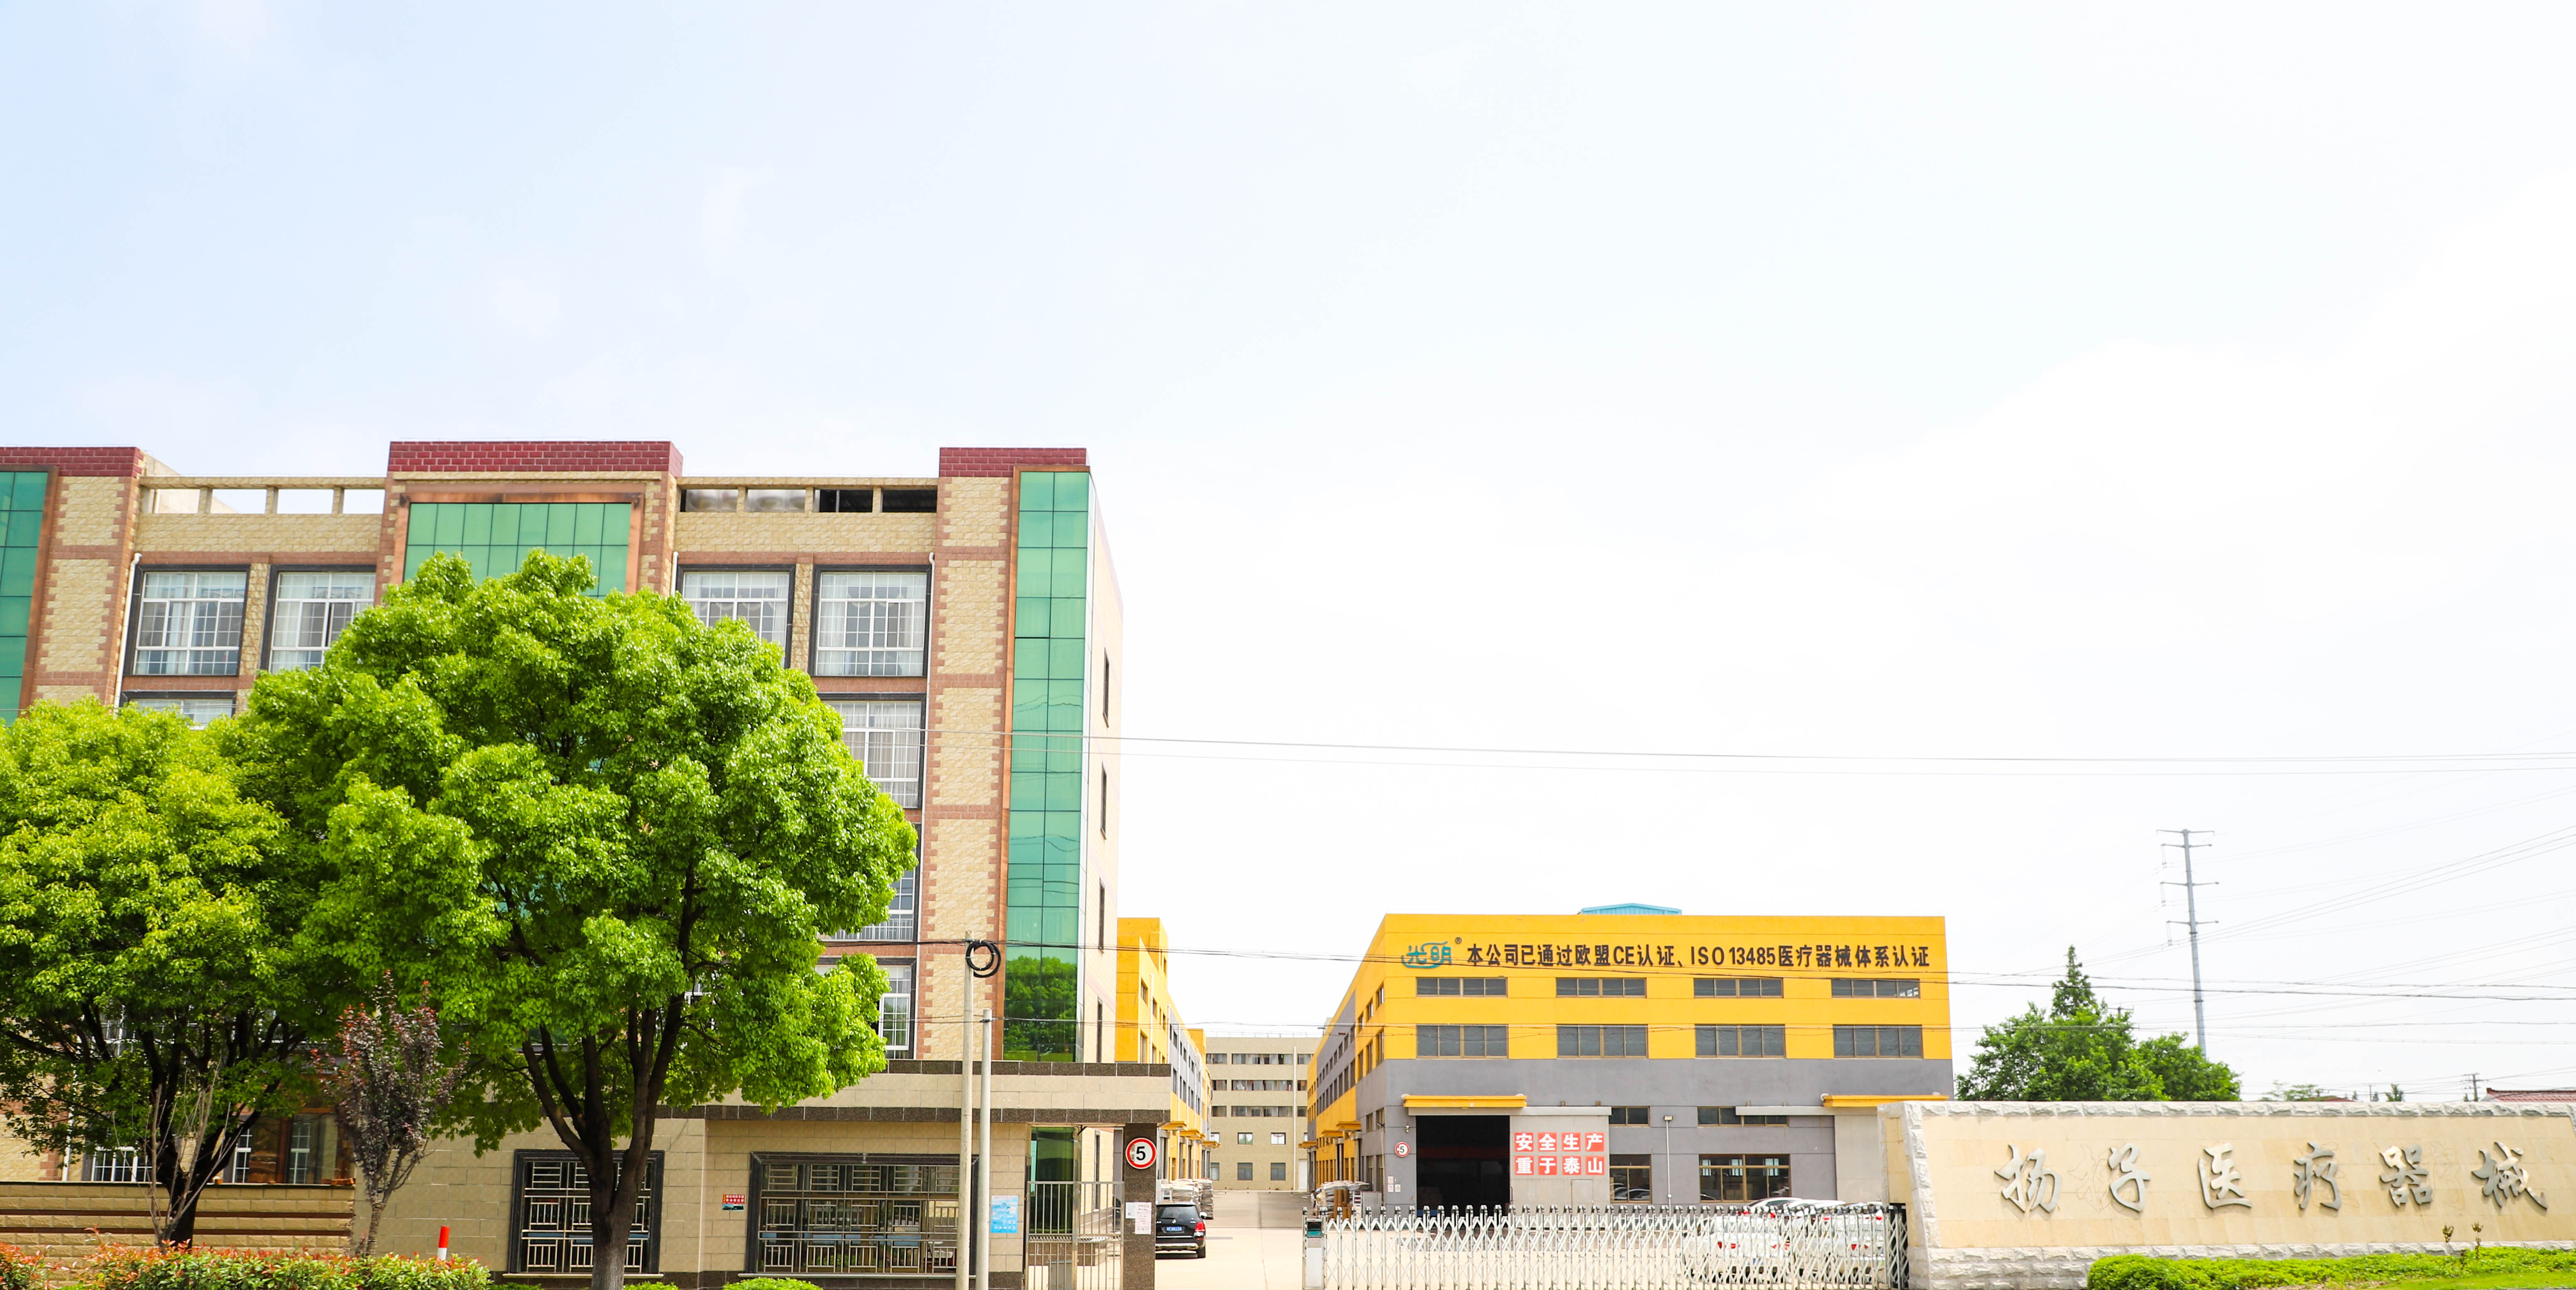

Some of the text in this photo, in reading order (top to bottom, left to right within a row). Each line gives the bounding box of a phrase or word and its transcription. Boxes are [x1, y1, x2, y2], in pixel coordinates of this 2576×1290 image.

[1515, 1133, 1603, 1151] 安全生产
[1136, 1146, 1146, 1161] 5
[1515, 1157, 1602, 1174] 重于泰山
[1994, 1141, 2548, 1213] 扬子医疗器械
